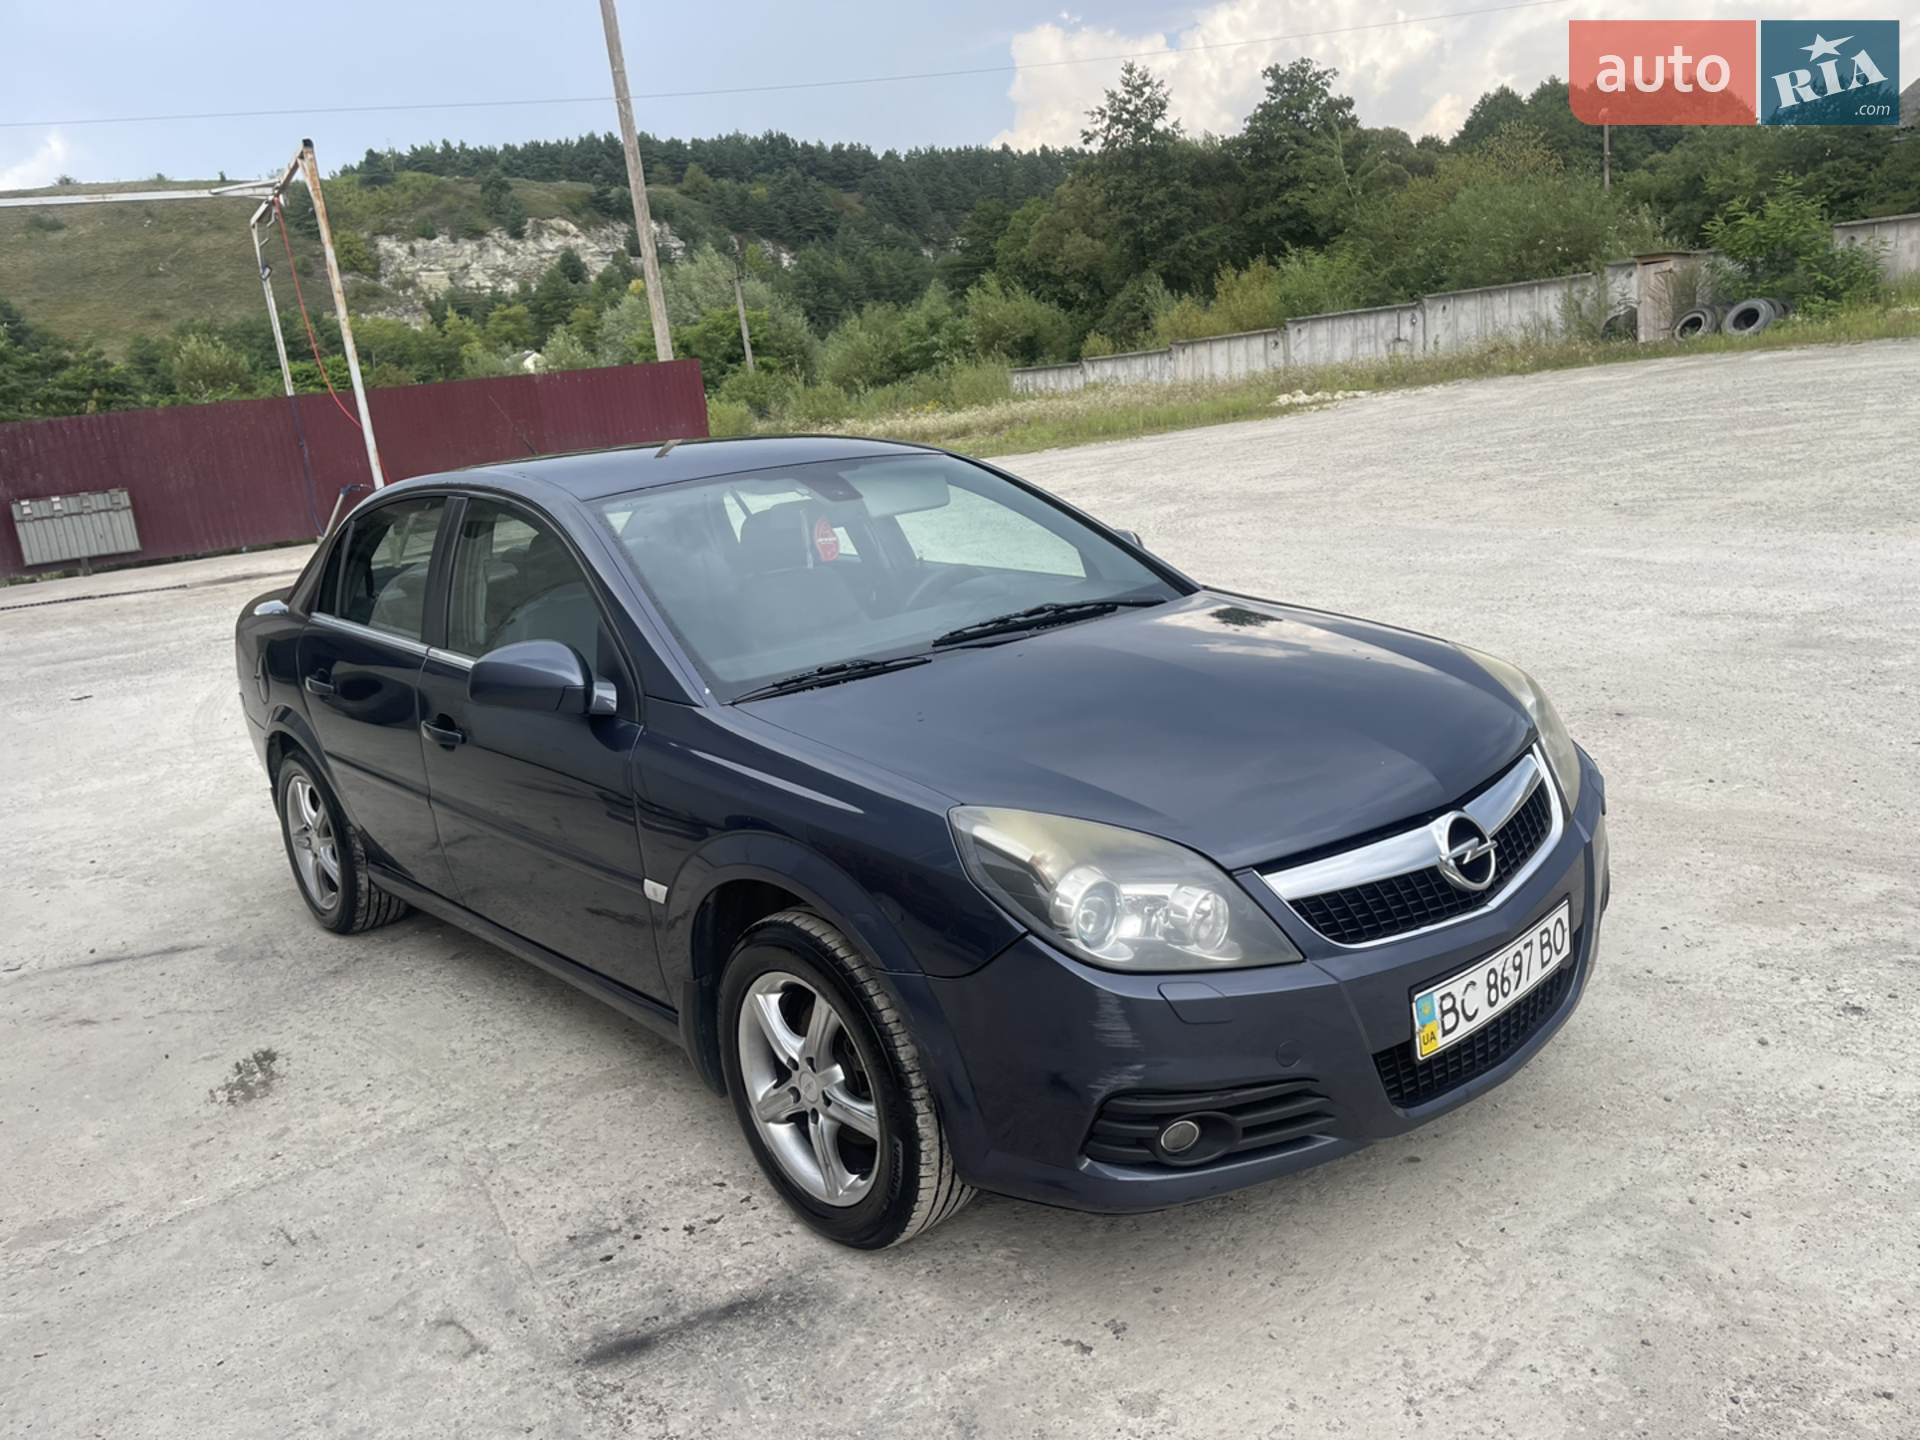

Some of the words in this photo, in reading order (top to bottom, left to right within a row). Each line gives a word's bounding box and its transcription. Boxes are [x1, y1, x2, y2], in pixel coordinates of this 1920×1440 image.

[1439, 980, 1479, 1038] BC
[1486, 938, 1533, 1008] 8697
[1539, 917, 1565, 970] BO
[1422, 1031, 1437, 1046] UA
